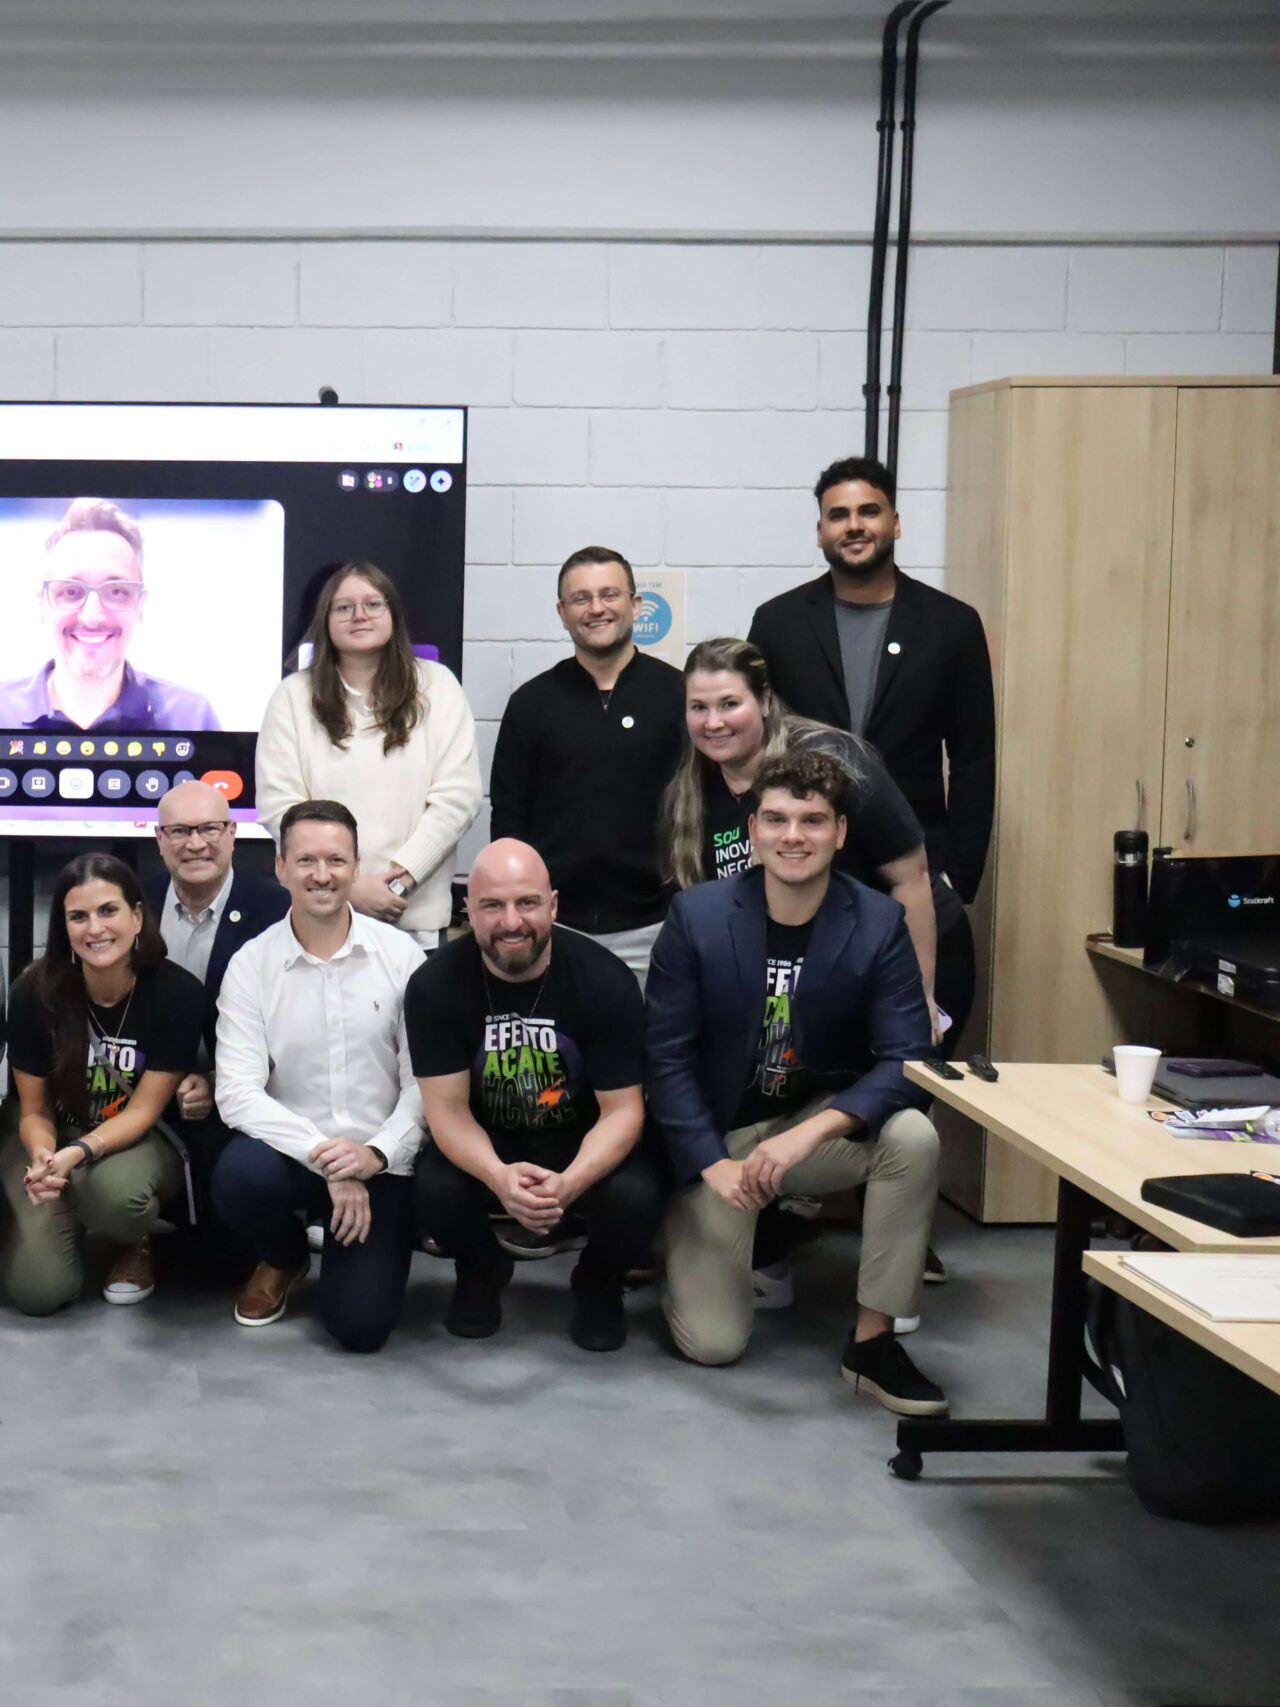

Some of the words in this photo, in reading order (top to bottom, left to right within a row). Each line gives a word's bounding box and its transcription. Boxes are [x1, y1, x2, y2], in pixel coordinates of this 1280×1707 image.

[632, 622, 659, 632] WIFI
[484, 1020, 557, 1053] EFEITO
[483, 1045, 560, 1078] ACATE
